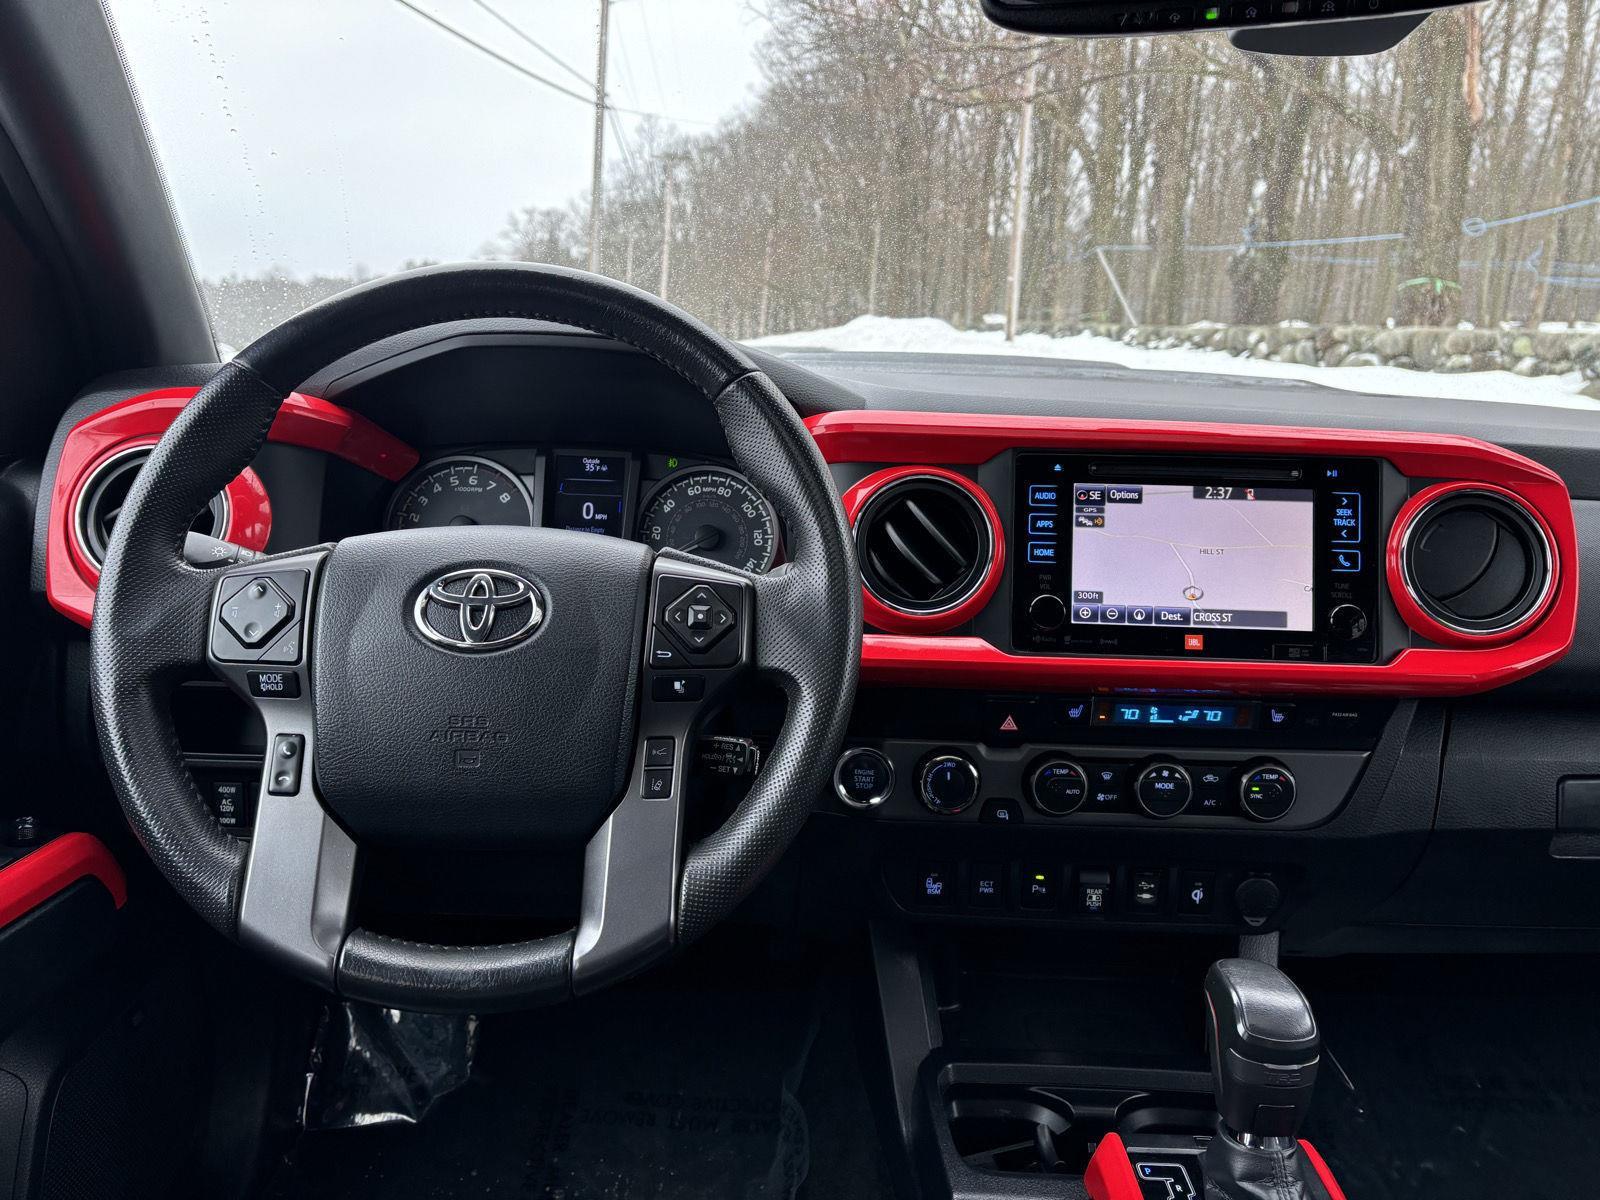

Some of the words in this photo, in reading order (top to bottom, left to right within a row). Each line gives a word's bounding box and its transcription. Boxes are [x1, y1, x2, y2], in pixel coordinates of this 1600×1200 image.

[450, 475, 460, 487] 5
[468, 475, 479, 486] 6
[486, 480, 497, 491] 7
[432, 482, 443, 494] 4
[687, 485, 702, 496] 60
[716, 486, 732, 498] 80
[1204, 486, 1233, 499] 2:37
[499, 492, 511, 504] 8
[1034, 491, 1057, 500] AUDIO
[1089, 490, 1102, 500] SE
[1109, 489, 1139, 500] Options
[418, 495, 429, 507] 3
[662, 499, 676, 514] 40
[582, 501, 594, 520] 0
[741, 501, 757, 518] 100
[1336, 508, 1353, 516] SEEK
[408, 512, 420, 523] 2
[1333, 518, 1356, 526] TRACK
[1036, 520, 1054, 528] APPS
[651, 526, 662, 541] 20
[753, 529, 763, 547] 120
[1033, 548, 1055, 557] HOME
[1077, 591, 1099, 600] 300ft
[1160, 611, 1184, 622] Dest.
[1193, 613, 1221, 622] CROSS
[1222, 613, 1233, 623] ST
[259, 673, 283, 683] MODE
[265, 683, 283, 691] HOLD
[1120, 708, 1140, 720] 70
[1203, 710, 1222, 722] 70
[1154, 782, 1175, 790] MODE
[222, 798, 233, 806] AC
[1203, 799, 1217, 807] A/C
[980, 880, 994, 888] ECT
[979, 887, 994, 895] PWR
[1144, 1167, 1152, 1175] P
[1175, 1184, 1183, 1193] R
